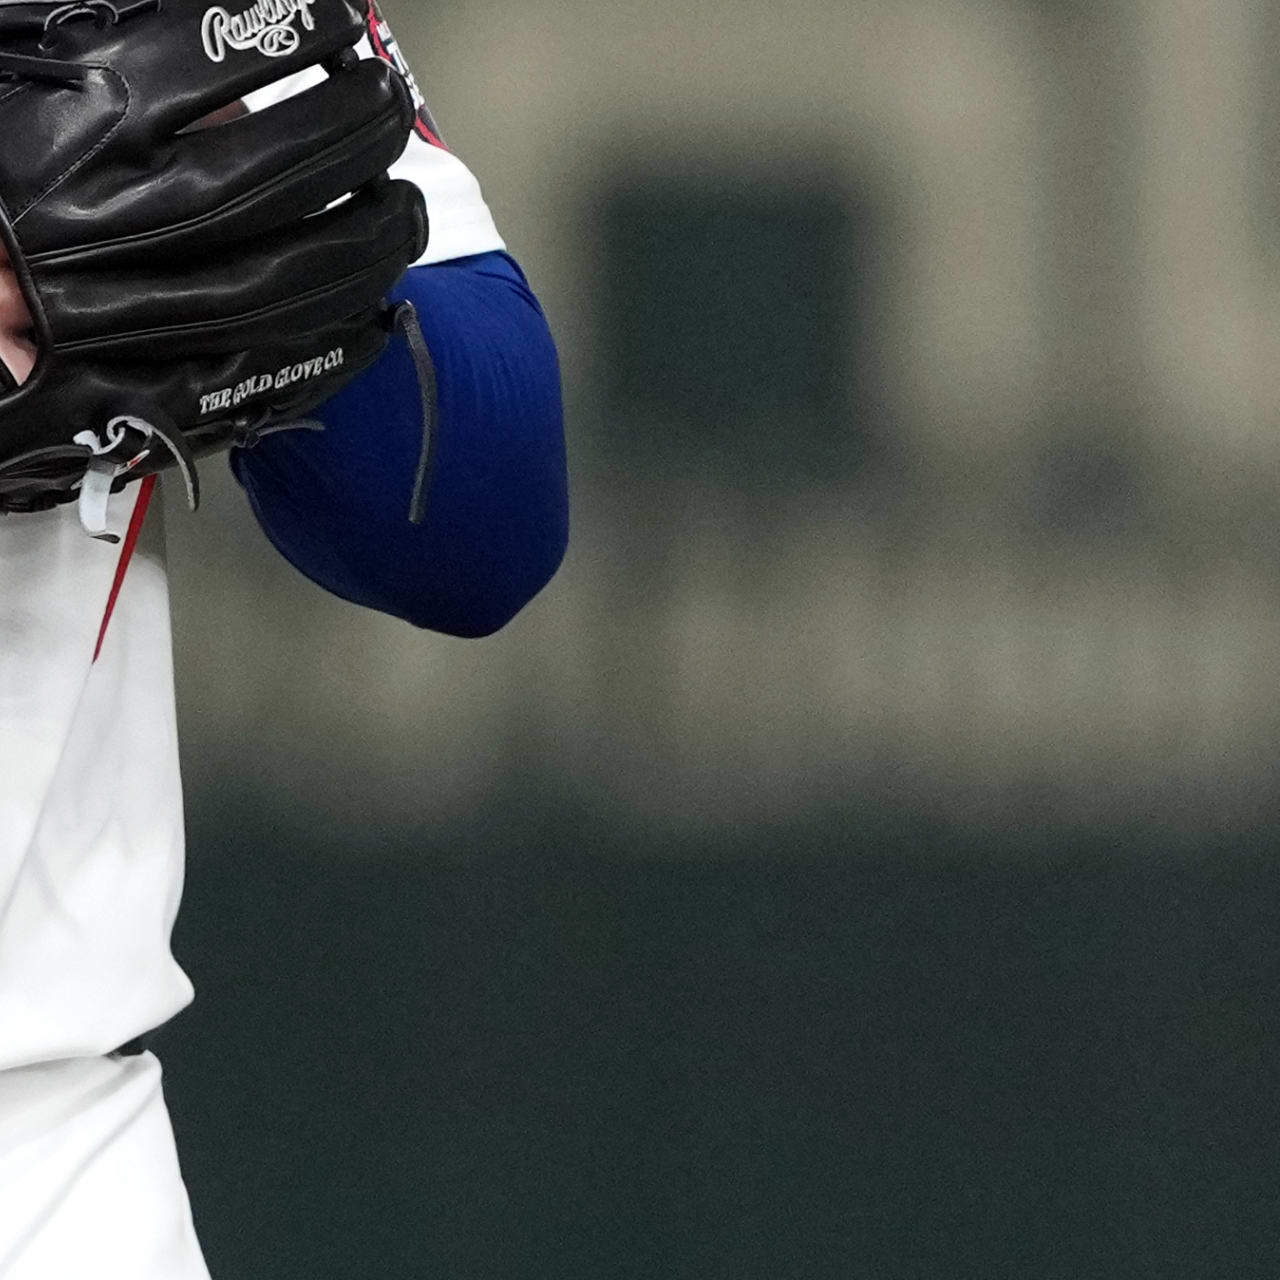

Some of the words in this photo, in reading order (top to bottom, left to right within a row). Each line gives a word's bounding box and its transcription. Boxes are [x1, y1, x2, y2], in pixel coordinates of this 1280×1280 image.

[199, 387, 233, 415] THE
[232, 373, 273, 406] GOLD
[274, 356, 324, 390] GLOVE
